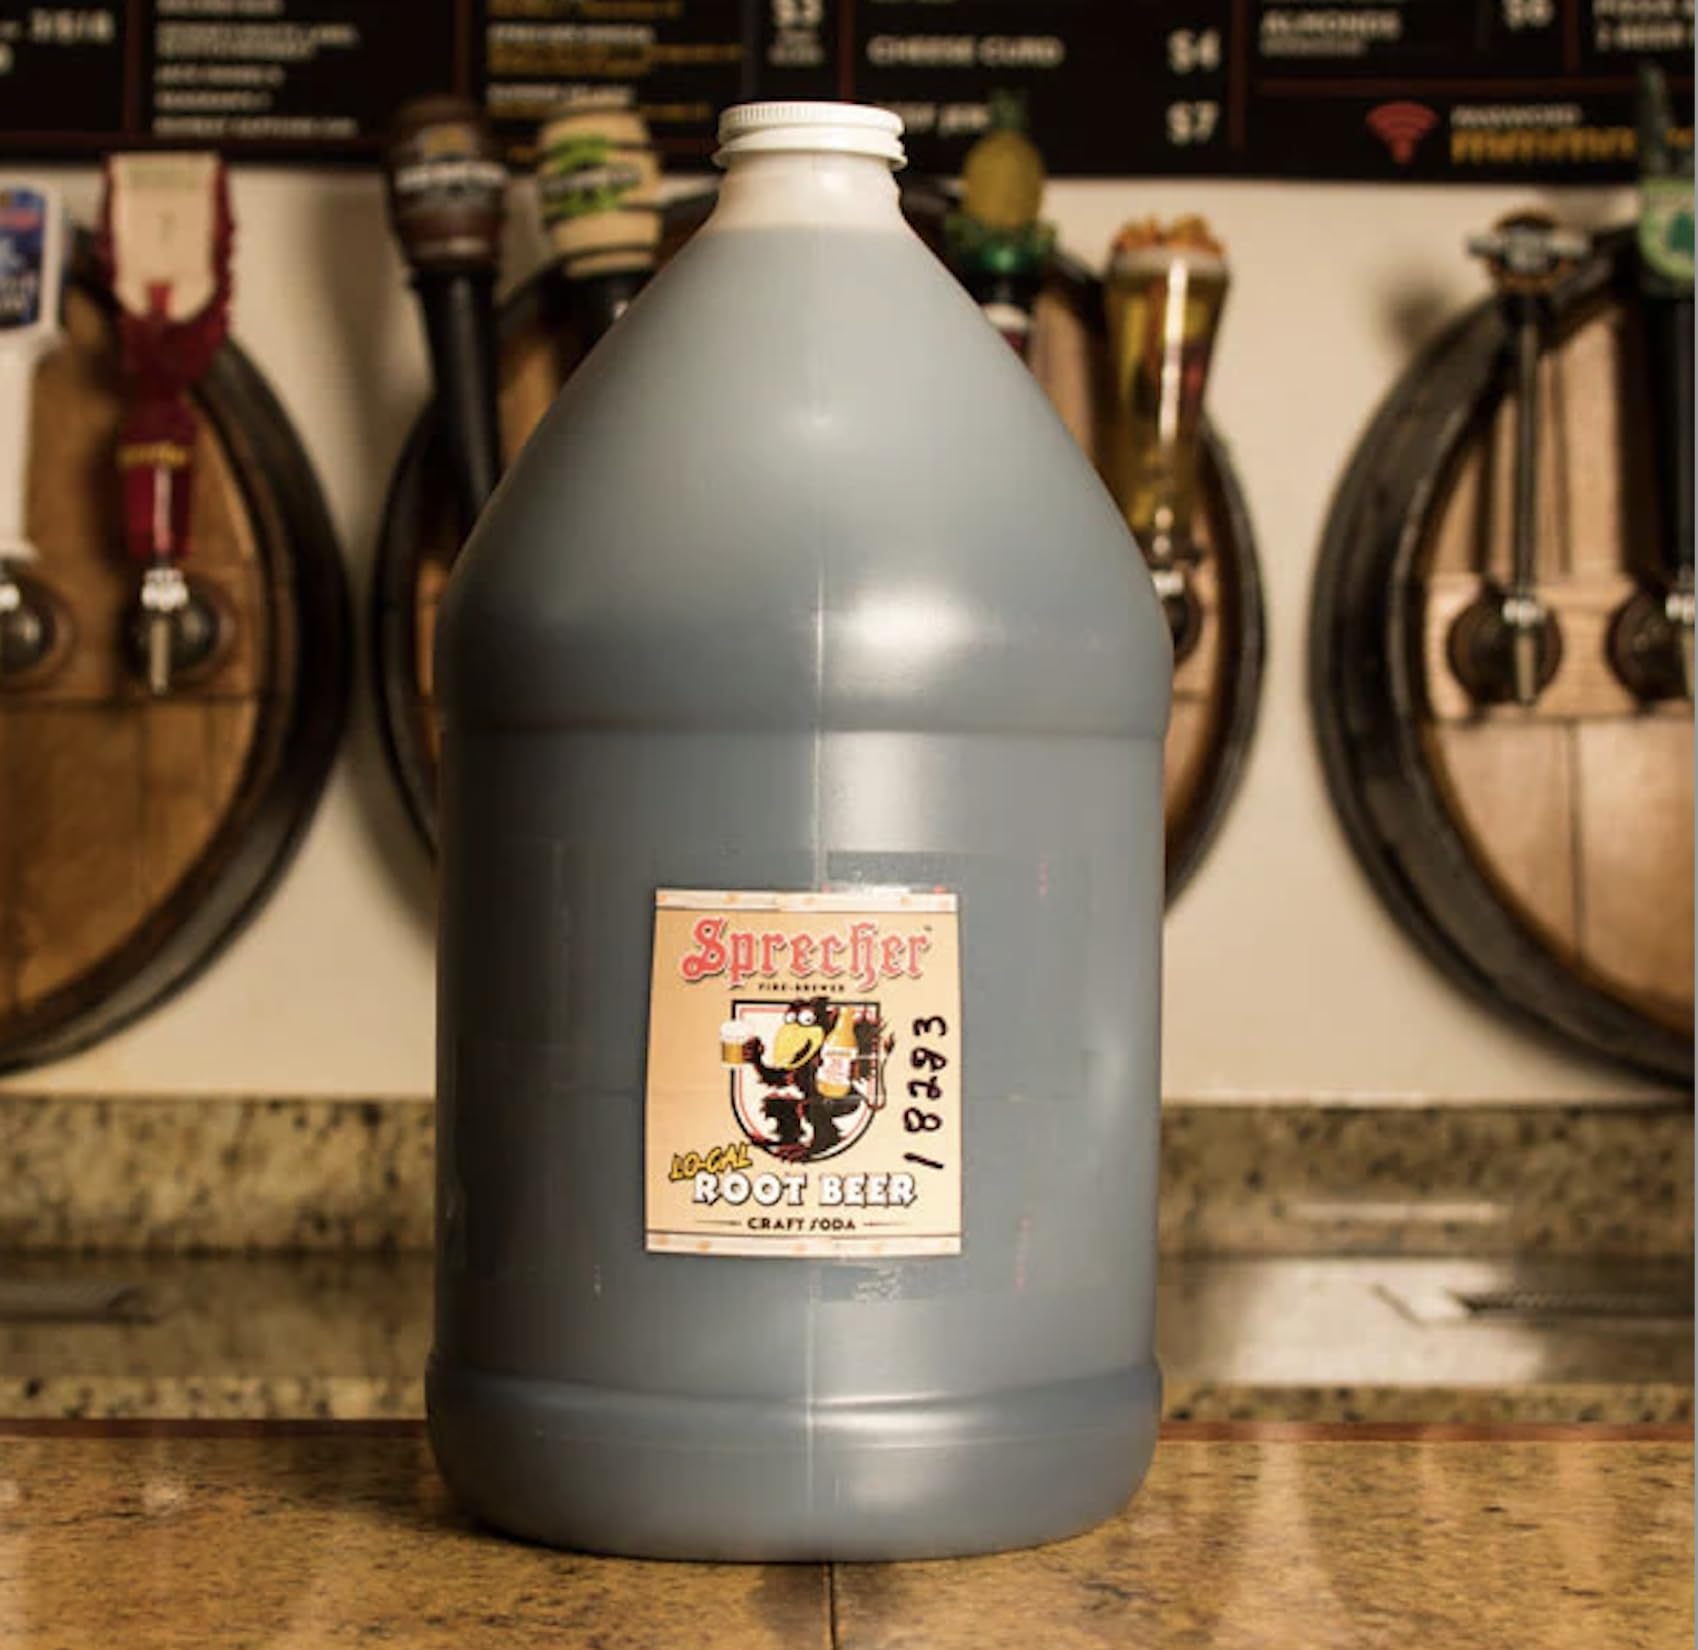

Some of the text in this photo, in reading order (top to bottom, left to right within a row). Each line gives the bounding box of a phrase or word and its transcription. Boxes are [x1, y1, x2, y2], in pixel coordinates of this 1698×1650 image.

[868, 30, 1220, 72] CHEESE CURD $4
[1167, 102, 1219, 145] $7
[682, 918, 931, 993] Sprecher
[692, 1172, 918, 1207] ROOT BEER
[747, 1217, 856, 1231] CRAFT SODA
